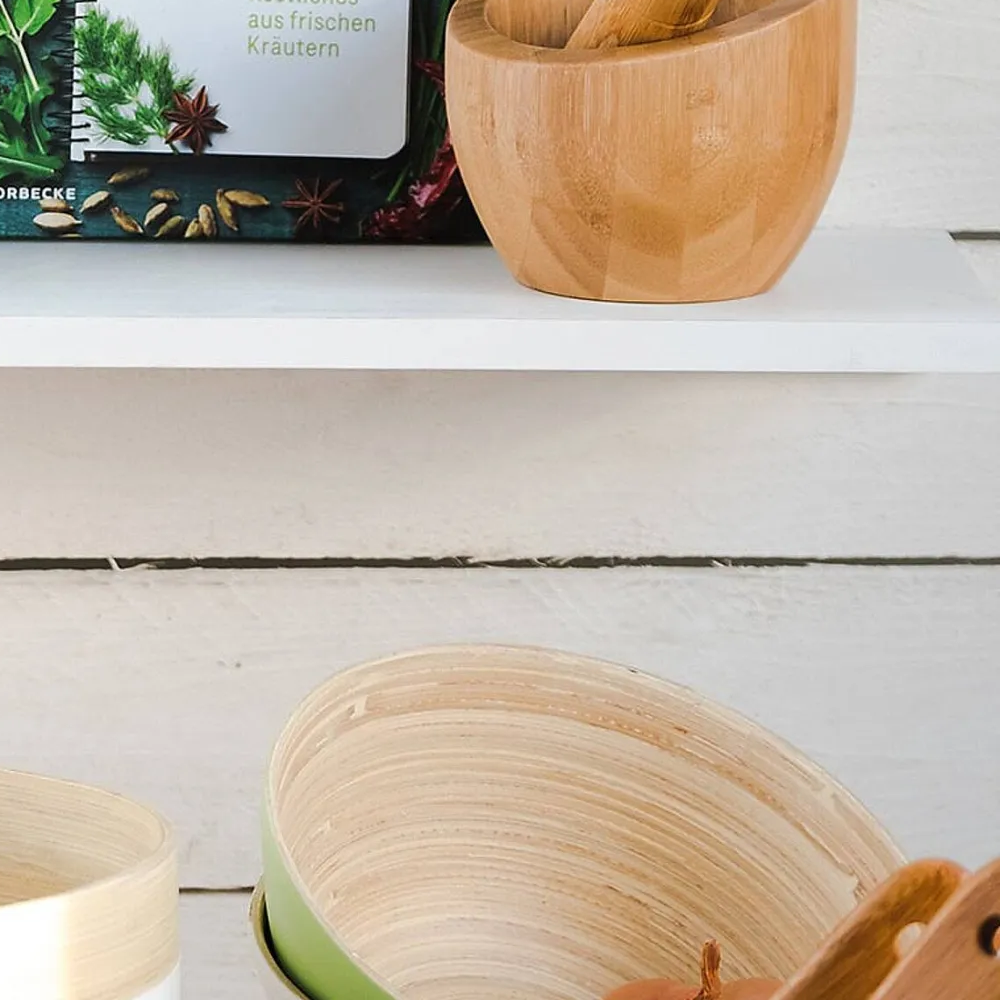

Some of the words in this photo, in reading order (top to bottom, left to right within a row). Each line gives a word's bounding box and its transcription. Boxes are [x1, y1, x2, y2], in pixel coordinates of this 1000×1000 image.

[249, 15, 284, 30] aus
[290, 11, 376, 33] frischen
[247, 35, 339, 58] Kräutern
